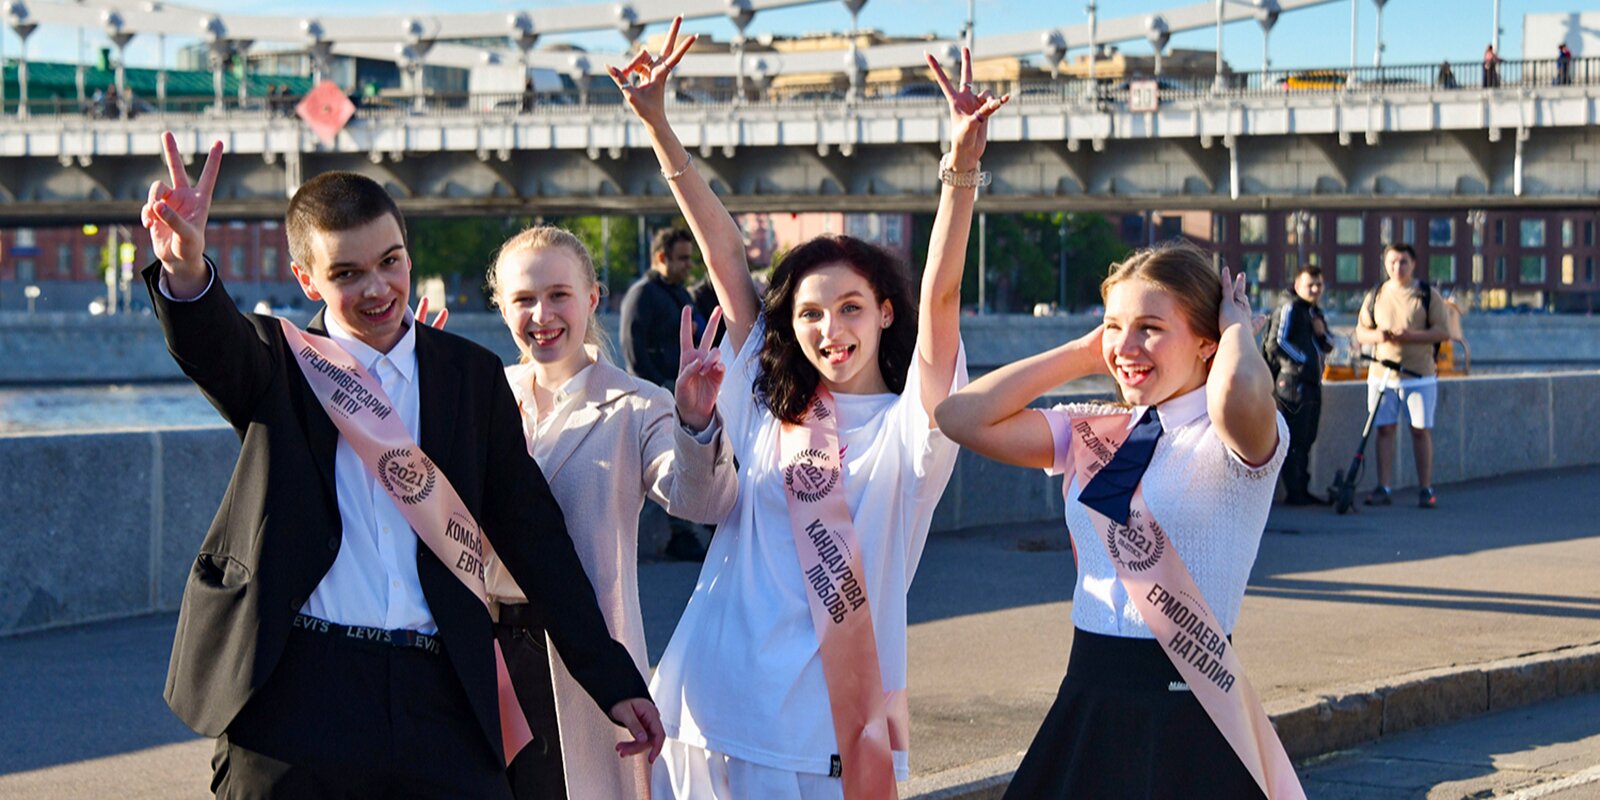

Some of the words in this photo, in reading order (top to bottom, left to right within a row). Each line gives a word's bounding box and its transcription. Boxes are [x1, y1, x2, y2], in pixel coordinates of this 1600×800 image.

[299, 345, 393, 420] ПРЕДУНИВЕРСАРИЙ
[330, 389, 362, 415] МГПУ
[388, 461, 424, 487] 2021
[800, 458, 827, 489] 2021
[1118, 524, 1153, 556] 2021
[804, 517, 867, 612] КАНДАУРОВА
[805, 562, 849, 625] ЛЮБОВЬ
[346, 626, 392, 642] LEVI'S
[1146, 583, 1226, 660] ЕРМОЛАЕВА
[1168, 631, 1236, 694] НАТАЛИЯ
